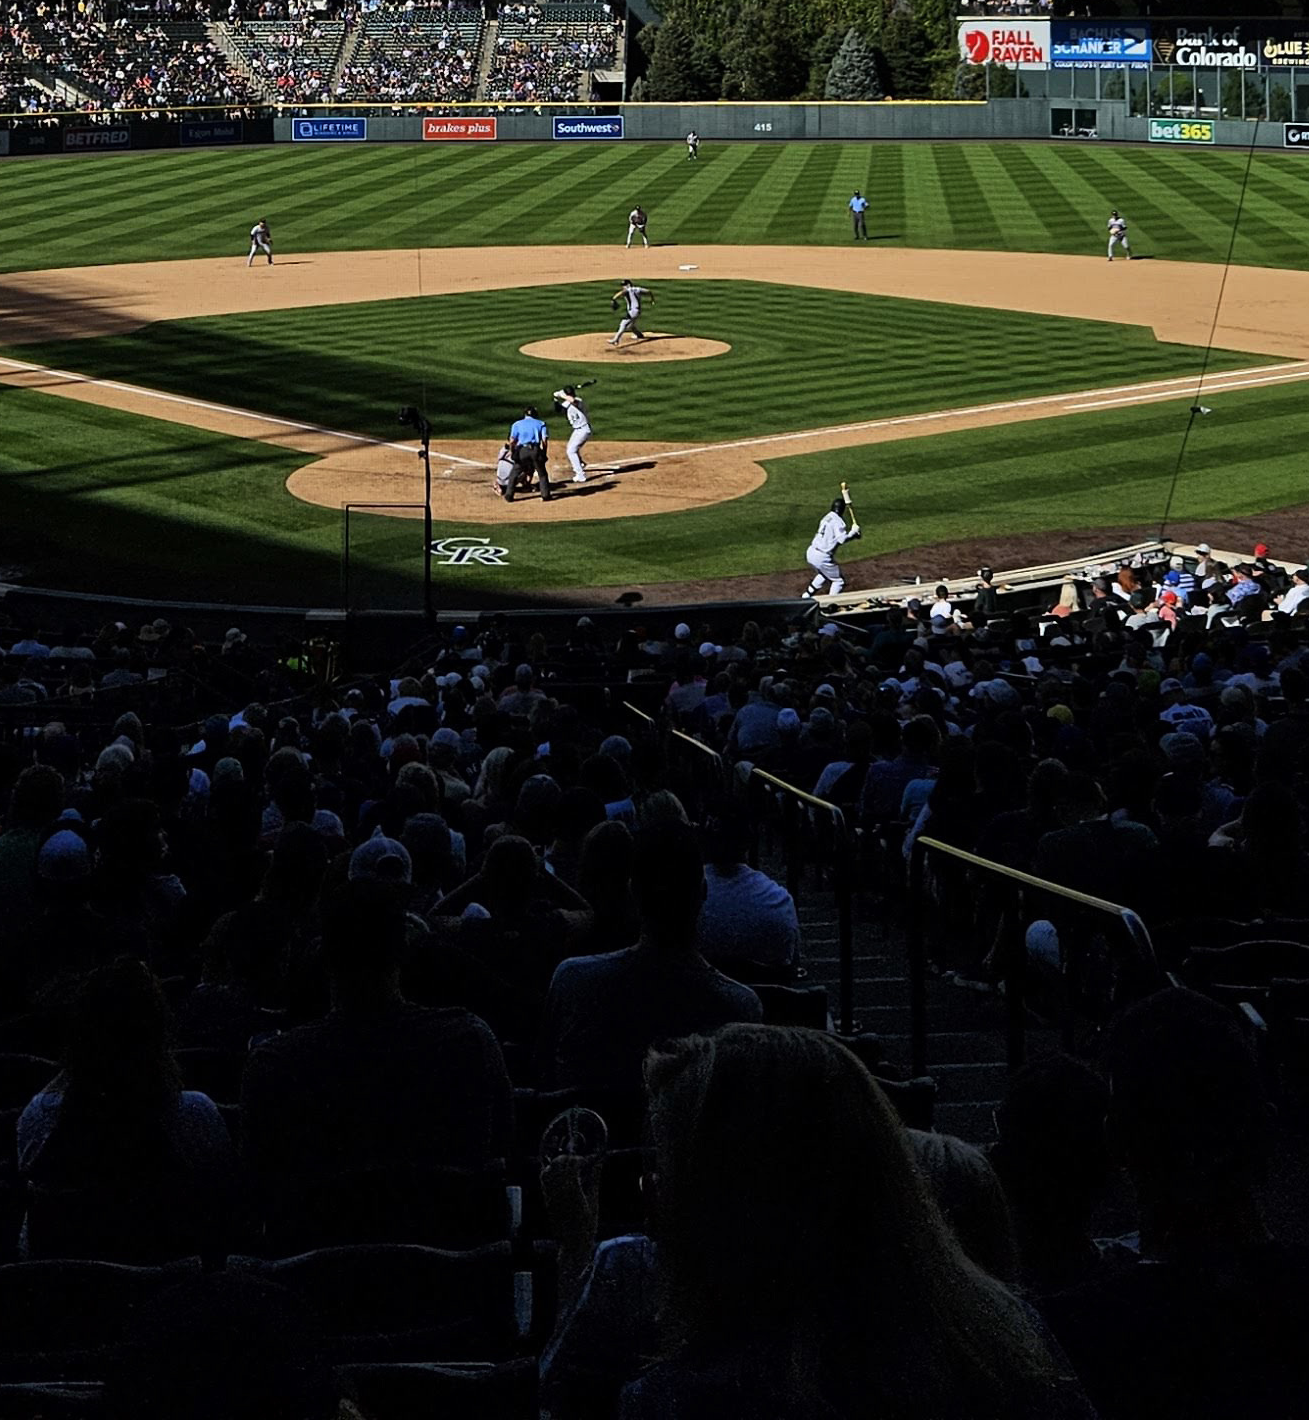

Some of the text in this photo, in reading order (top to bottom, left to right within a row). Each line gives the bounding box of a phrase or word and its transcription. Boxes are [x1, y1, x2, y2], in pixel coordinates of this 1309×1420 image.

[992, 30, 1034, 45] FJALL
[1070, 27, 1121, 40] BACHUS
[1176, 26, 1241, 47] Bank of
[993, 47, 1043, 63] RAVEN
[1263, 37, 1303, 59] BLUE
[1175, 46, 1257, 67] Colorado
[313, 123, 359, 132] LIFETIME
[428, 122, 491, 134] brakes plus
[557, 122, 612, 134] Southwest
[754, 123, 773, 132] 415
[1151, 121, 1212, 141] bet365
[65, 131, 129, 145] BETFRED
